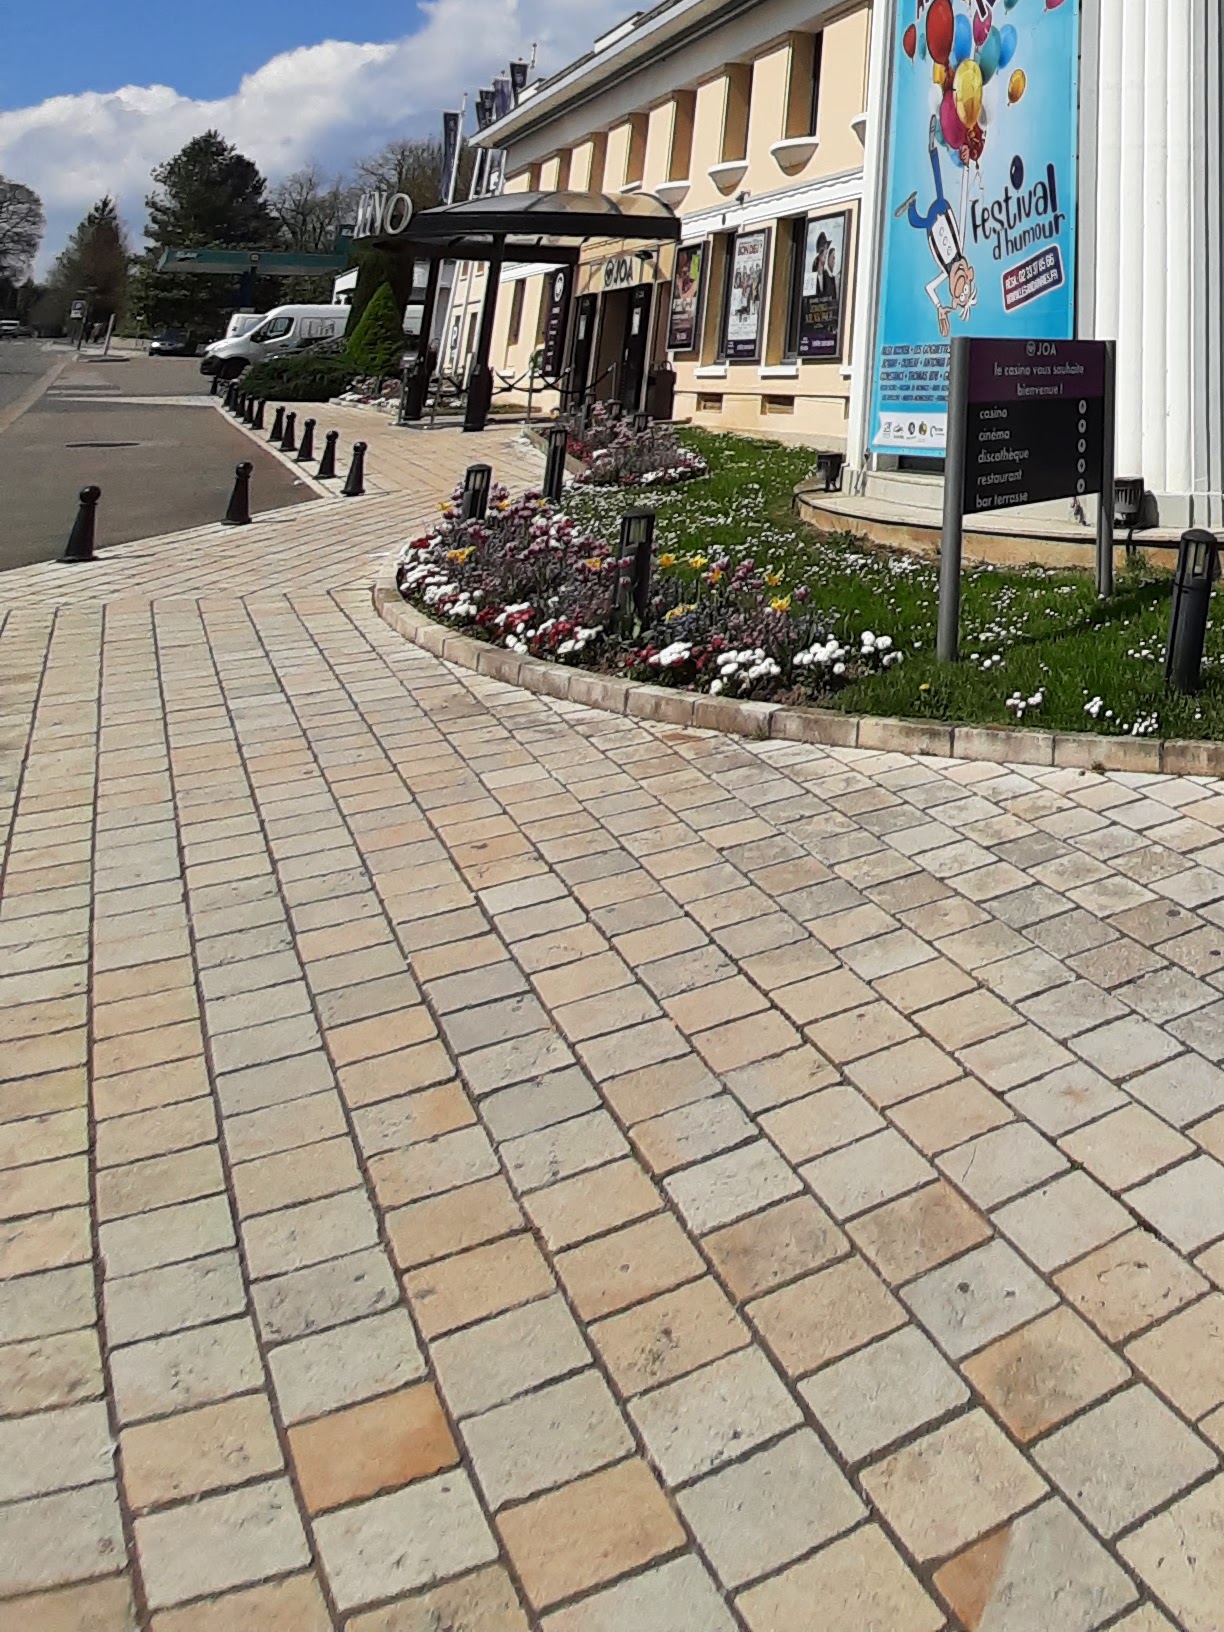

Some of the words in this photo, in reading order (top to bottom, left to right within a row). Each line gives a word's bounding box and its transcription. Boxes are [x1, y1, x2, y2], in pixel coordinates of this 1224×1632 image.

[971, 163, 1058, 244] Festival
[614, 257, 633, 285] JOA
[1037, 342, 1057, 356] JOA
[994, 362, 1002, 376] le
[1004, 363, 1031, 376] casino
[1032, 365, 1051, 376] vous
[1053, 362, 1084, 374] souhaite
[979, 406, 1008, 419] casino
[978, 427, 1010, 442] cinéma
[977, 447, 1030, 464] discothèque
[977, 469, 1023, 486] restaurant
[976, 494, 992, 508] bar
[993, 491, 1029, 507] terrasse
